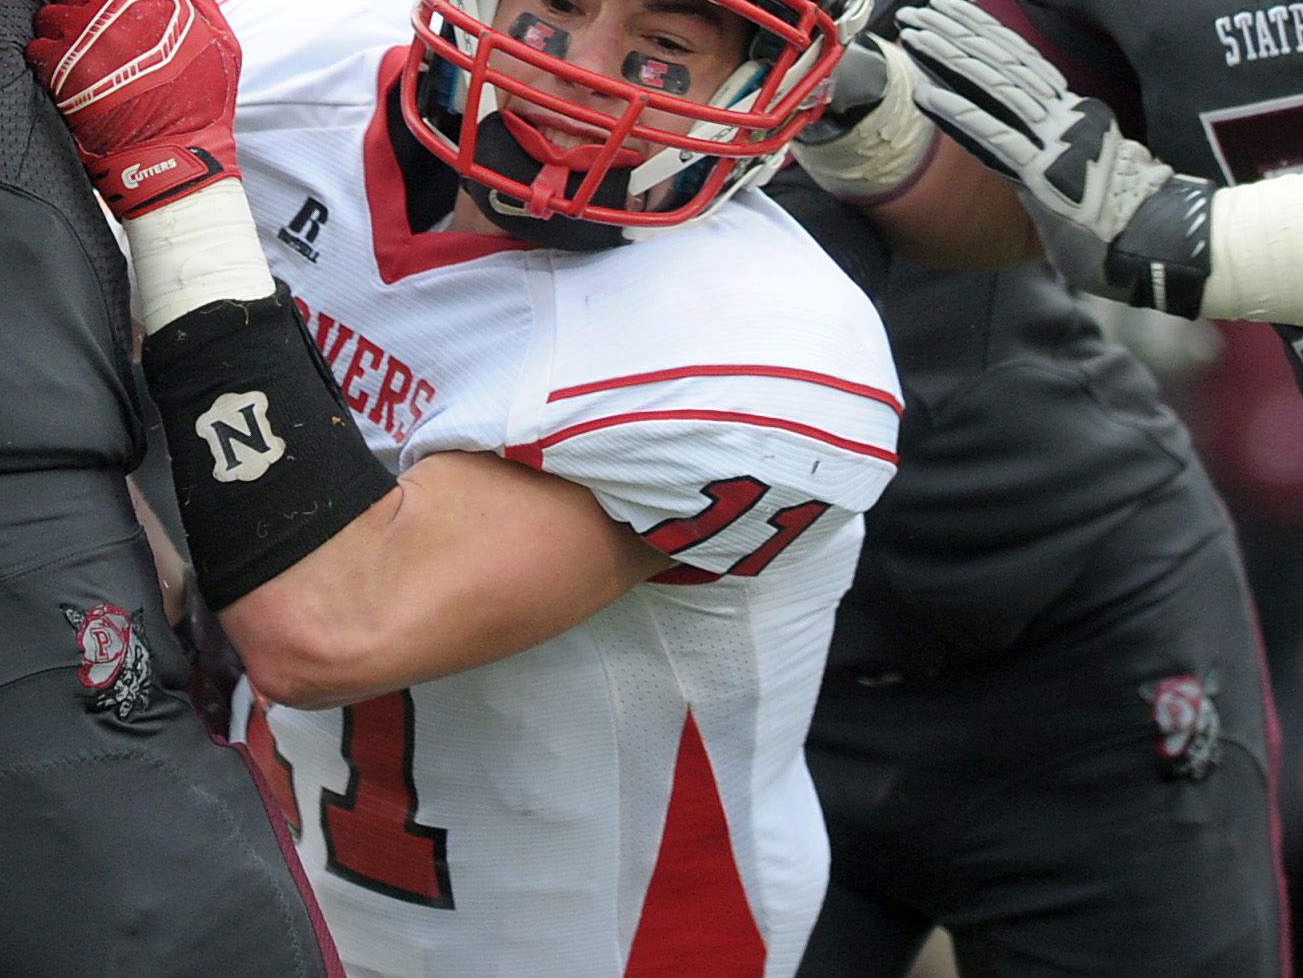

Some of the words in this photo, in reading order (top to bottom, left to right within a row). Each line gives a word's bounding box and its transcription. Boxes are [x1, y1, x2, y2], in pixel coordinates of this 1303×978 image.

[289, 196, 328, 243] R
[210, 403, 271, 471] N
[92, 629, 111, 661] P
